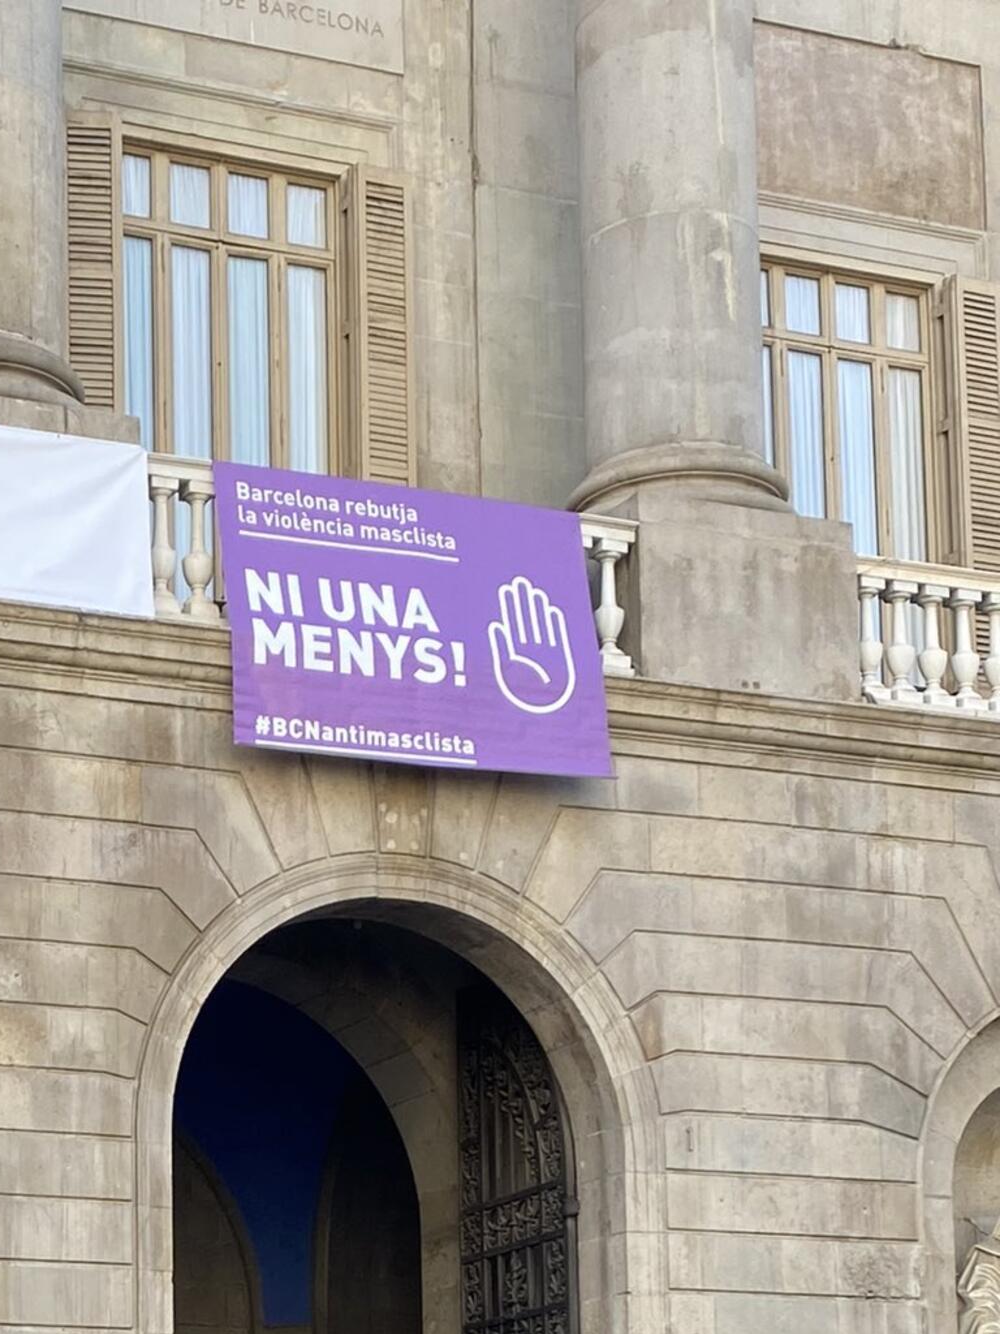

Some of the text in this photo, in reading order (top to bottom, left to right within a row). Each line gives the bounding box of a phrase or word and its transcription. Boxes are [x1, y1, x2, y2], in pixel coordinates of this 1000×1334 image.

[258, 0, 385, 38] BARCELONA
[236, 481, 418, 525] Barcelona rebutja
[237, 505, 456, 550] la violència masclista
[244, 568, 440, 633] NI UNA
[251, 618, 467, 688] MENYS!
[255, 715, 475, 755] #BCNantimasclista
